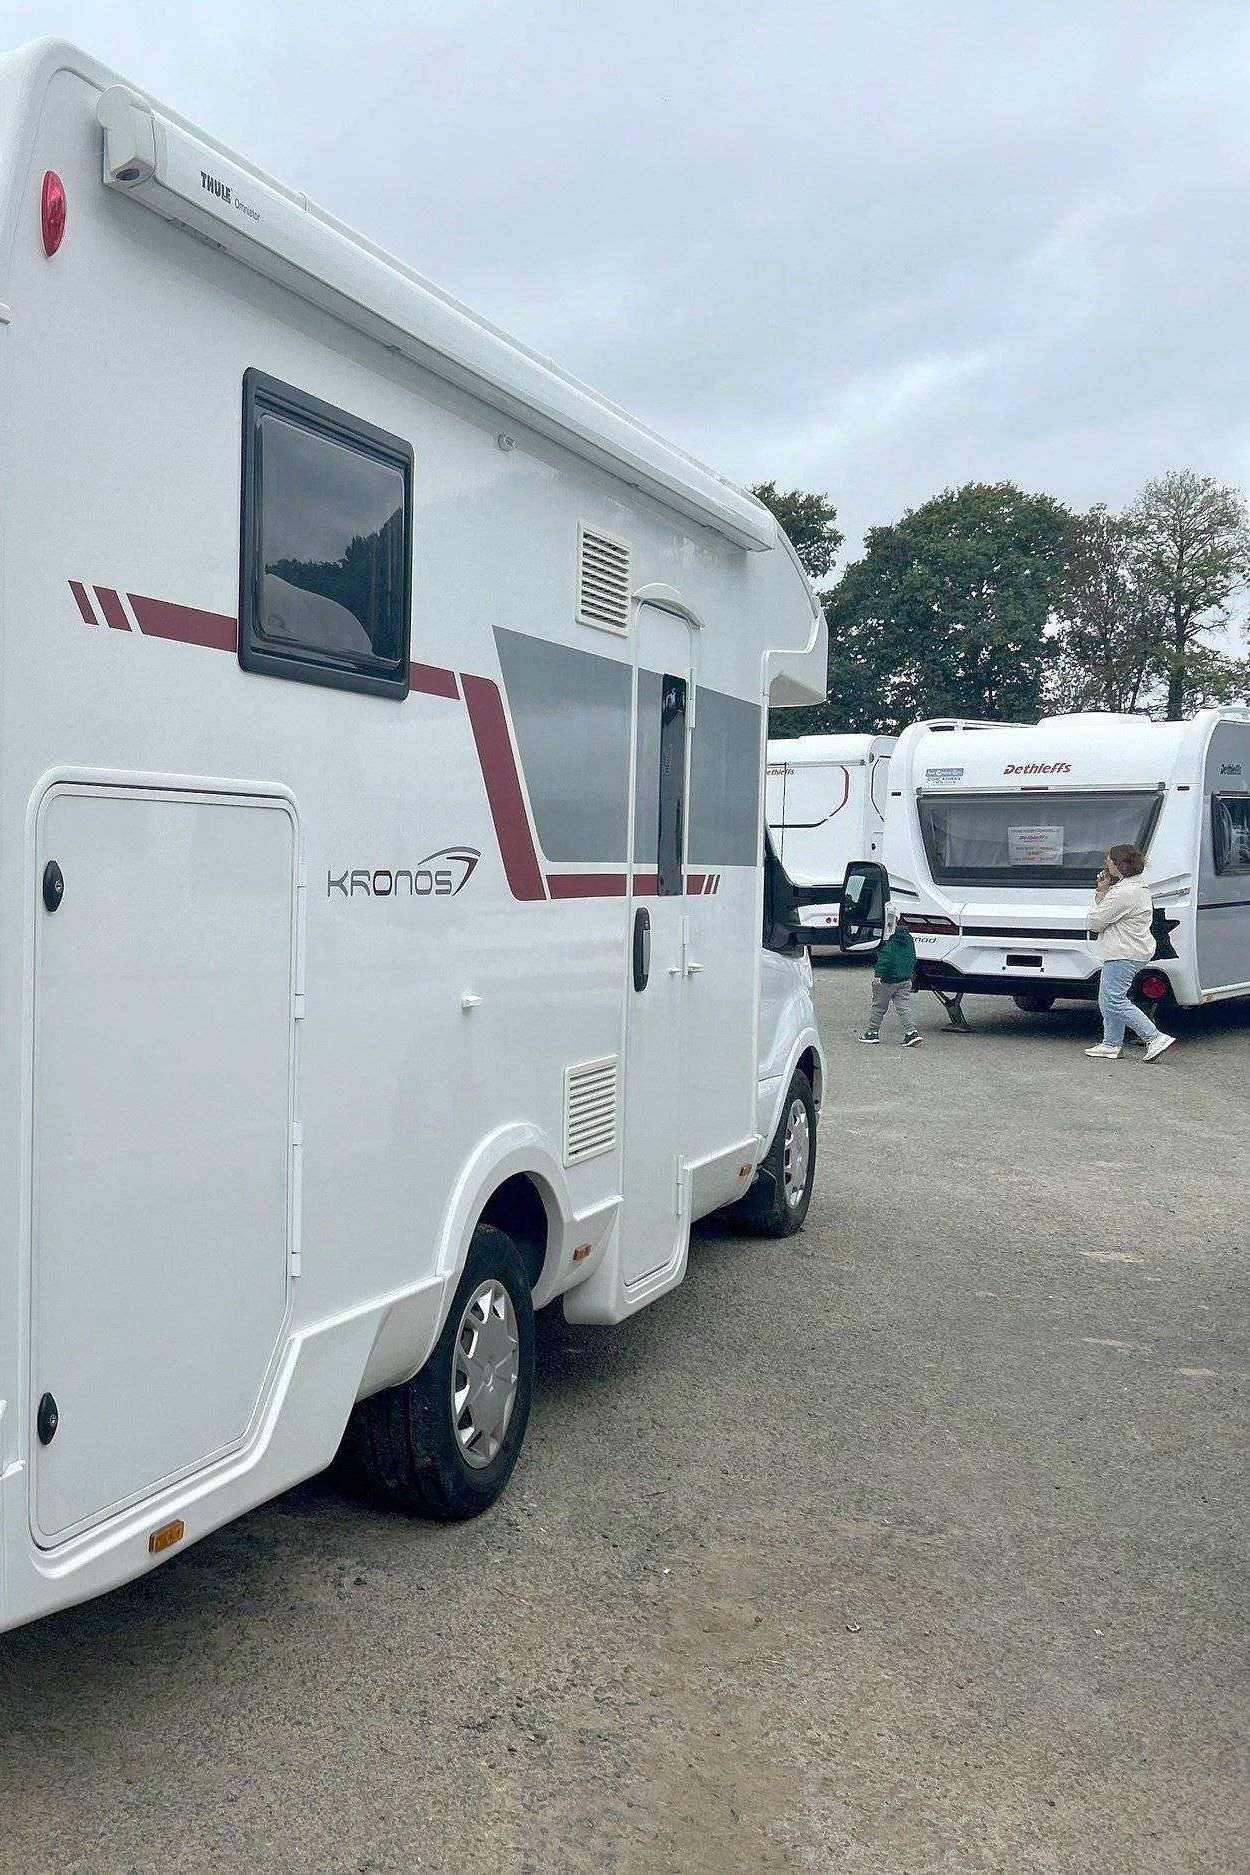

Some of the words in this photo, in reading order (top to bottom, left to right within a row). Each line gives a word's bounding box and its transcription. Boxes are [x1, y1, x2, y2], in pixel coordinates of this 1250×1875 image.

[200, 170, 232, 204] THULE
[1003, 762, 1072, 775] Dethleffs
[327, 869, 453, 897] KRONOS
